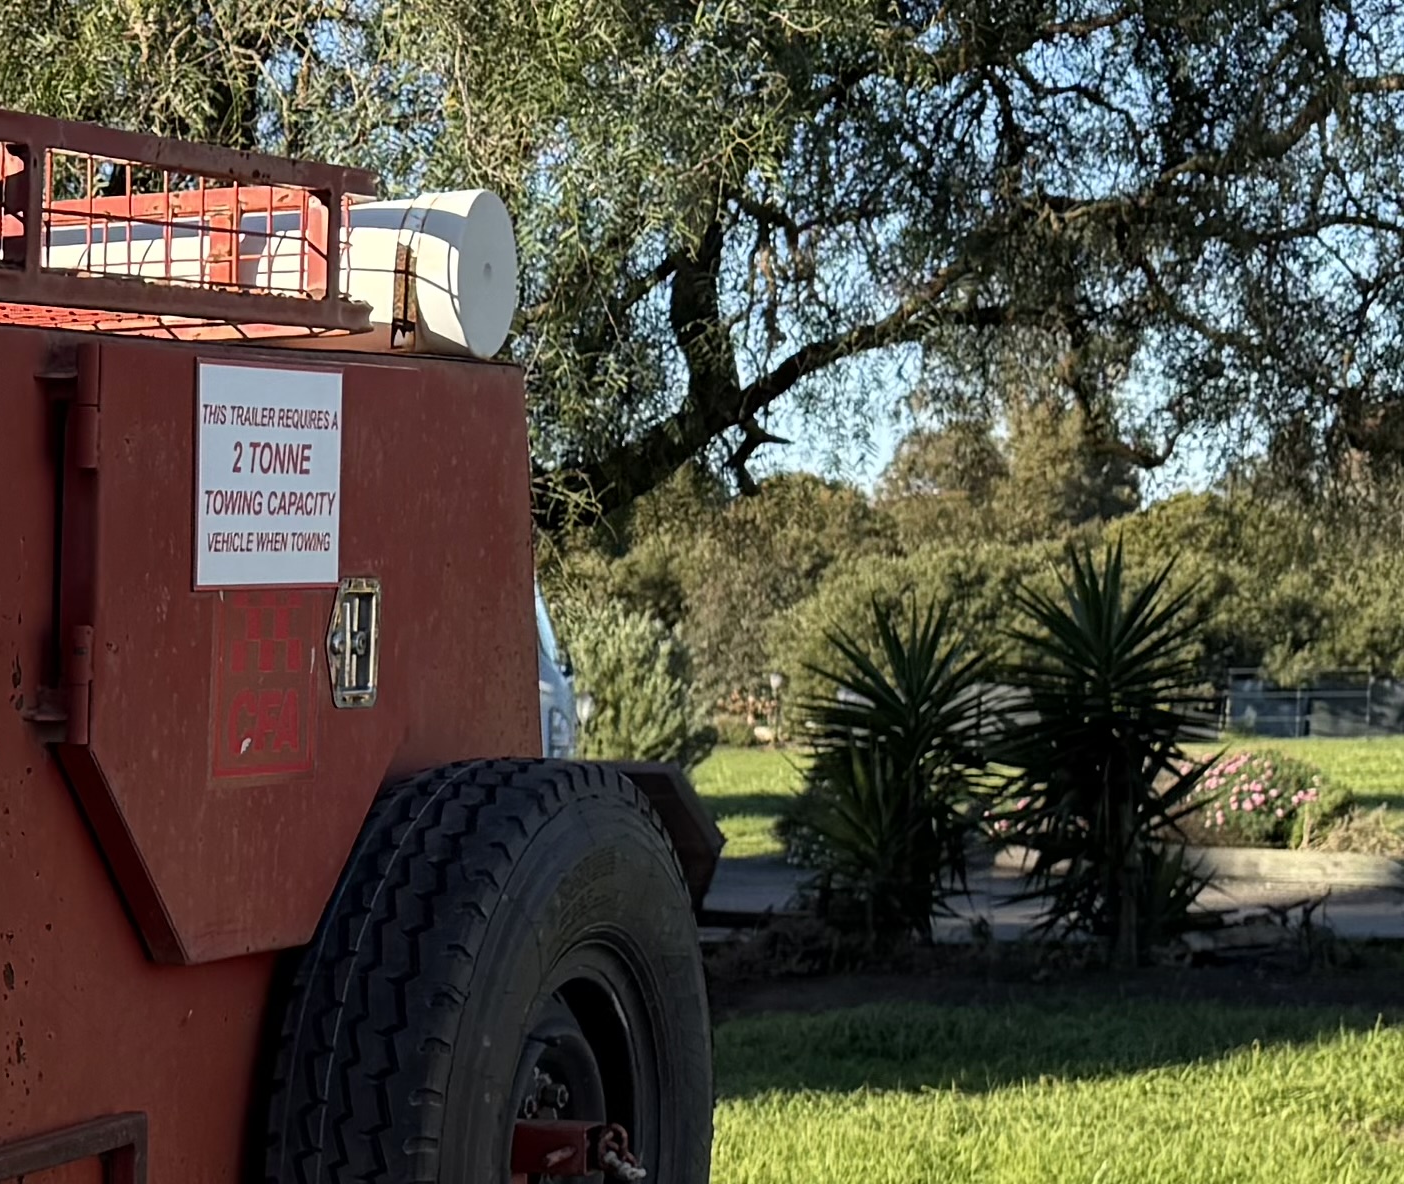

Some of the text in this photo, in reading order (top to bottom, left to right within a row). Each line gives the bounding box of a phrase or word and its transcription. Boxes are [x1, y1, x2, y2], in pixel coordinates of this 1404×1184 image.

[203, 404, 339, 430] THIS TRAILER REQUIRES A
[232, 441, 312, 475] 2 TONNE
[205, 490, 337, 516] TOWING CAPACITY
[208, 532, 331, 552] VEHICLE WHEN TOWING
[227, 688, 300, 754] CFA
